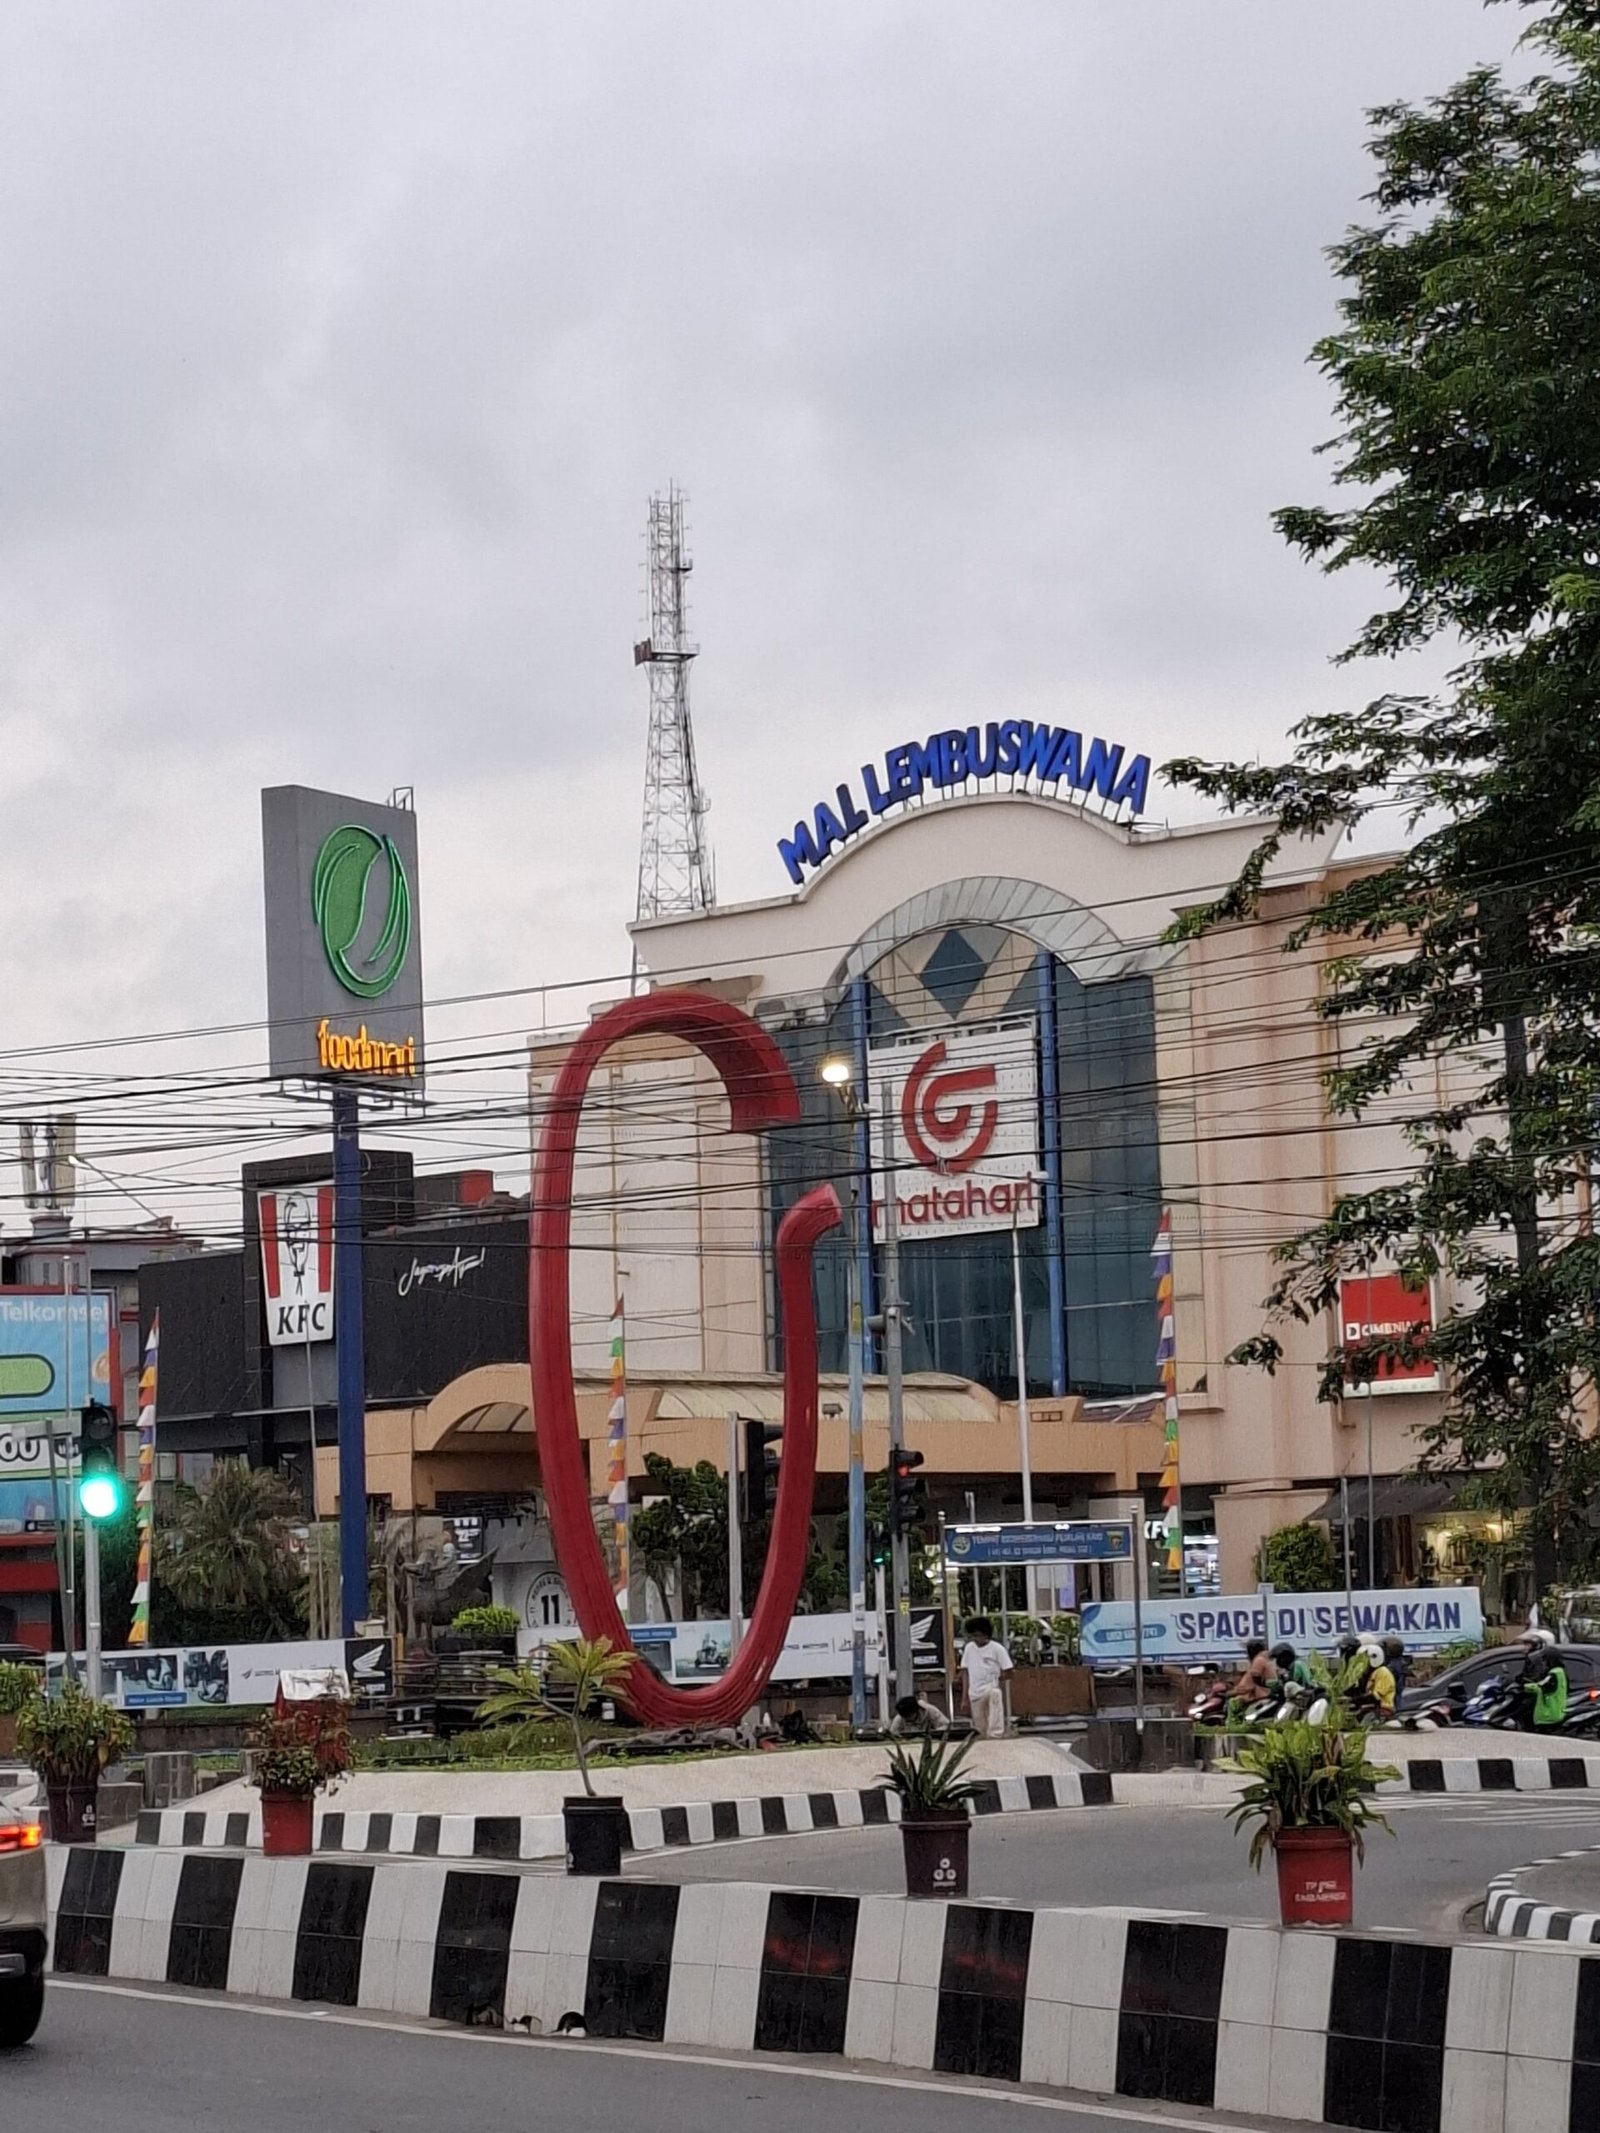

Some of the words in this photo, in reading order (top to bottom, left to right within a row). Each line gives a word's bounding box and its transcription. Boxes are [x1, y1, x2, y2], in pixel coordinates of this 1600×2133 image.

[777, 783, 870, 885] MAL
[861, 719, 1152, 815] LEMBUSWANA
[1, 1300, 109, 1323] Telkomsel
[277, 1302, 327, 1335] KFC
[1178, 1611, 1266, 1641] SPACE
[1277, 1607, 1307, 1637] DI
[1314, 1601, 1463, 1638] SEWAKAN
